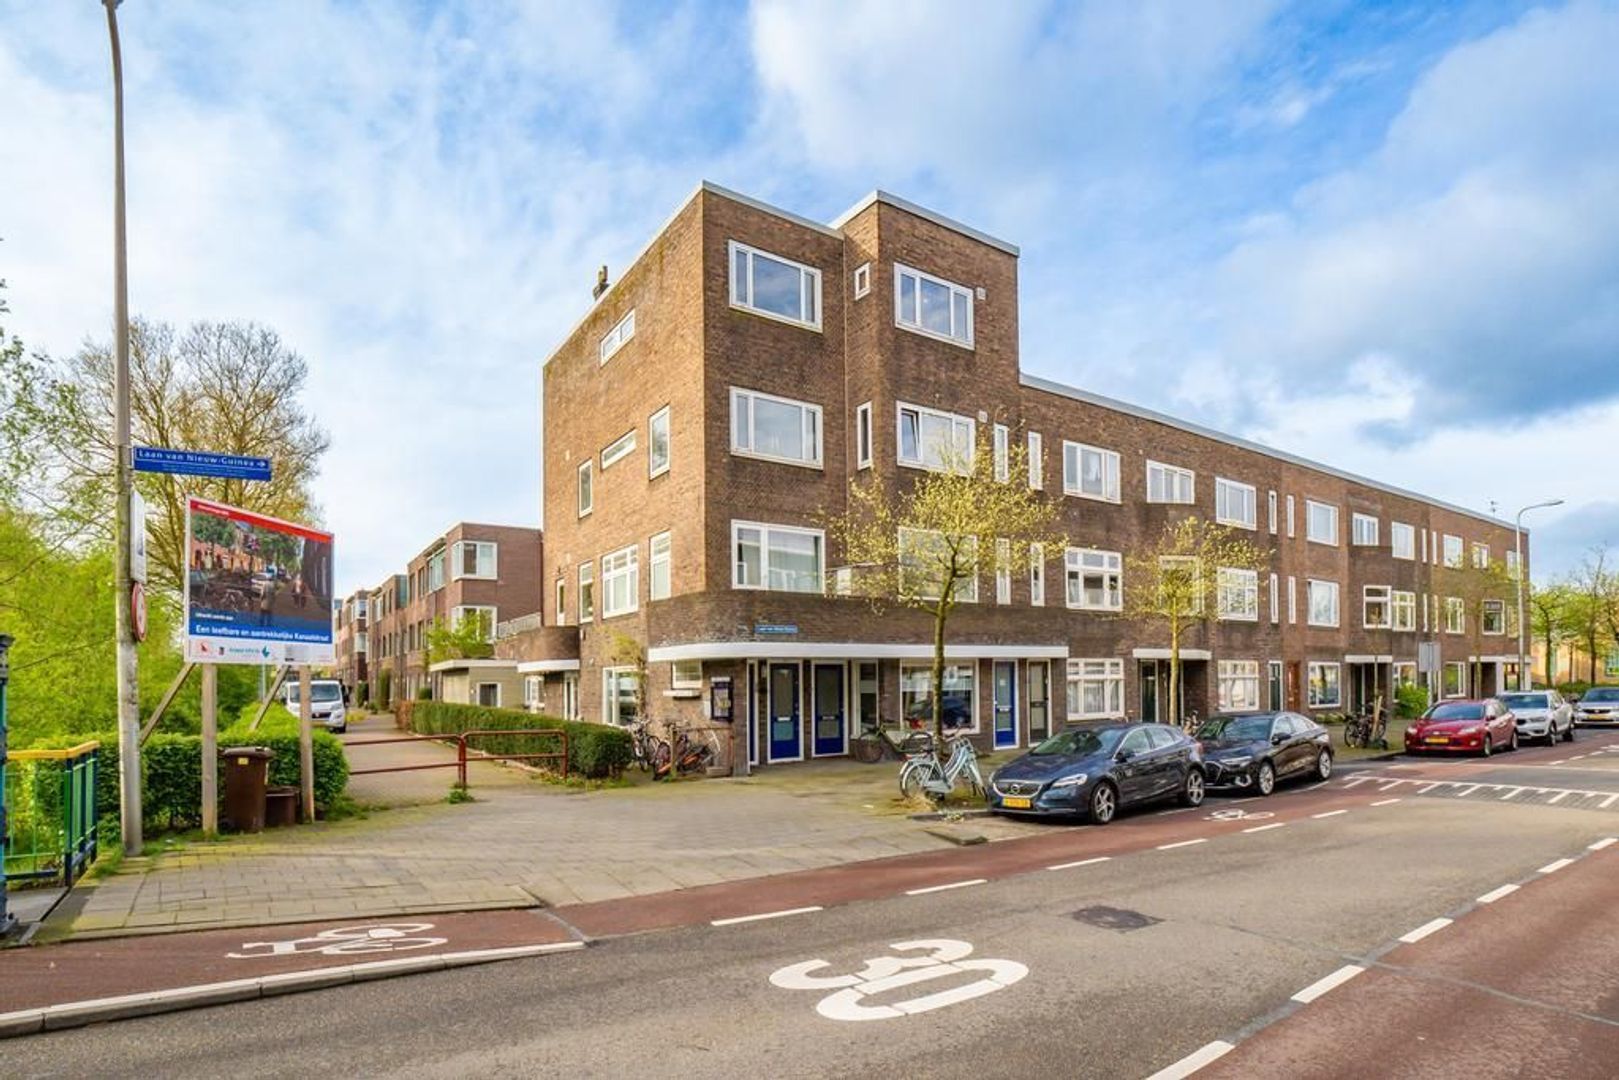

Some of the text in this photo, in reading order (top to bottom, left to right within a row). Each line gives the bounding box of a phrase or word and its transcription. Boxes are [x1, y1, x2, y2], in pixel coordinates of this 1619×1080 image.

[139, 448, 254, 467] Laan van Nieuw-Guinea
[195, 624, 210, 634] Een
[769, 939, 1029, 1021] 30
